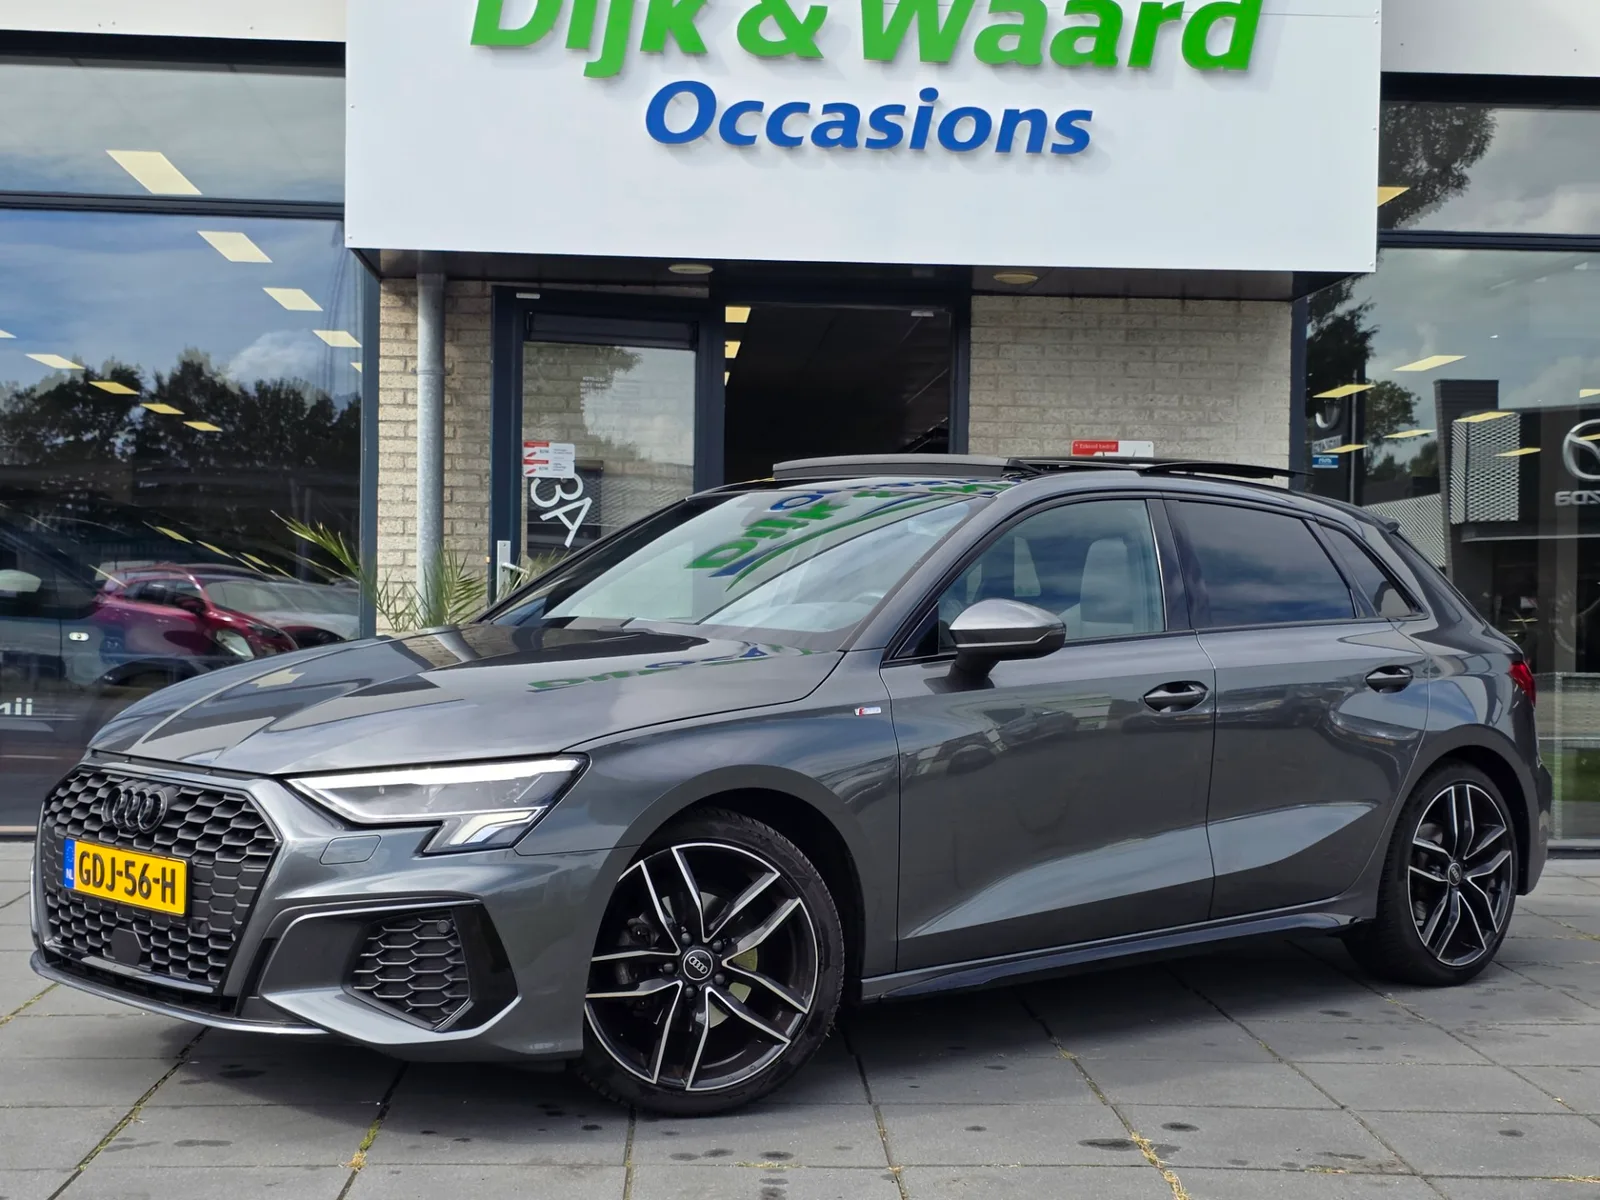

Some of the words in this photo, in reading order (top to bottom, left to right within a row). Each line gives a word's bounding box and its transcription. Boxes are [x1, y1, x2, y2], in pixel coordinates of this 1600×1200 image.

[736, 0, 828, 58] &
[860, 0, 1263, 71] Waard
[645, 80, 1094, 155] Occasions
[65, 868, 74, 880] NL
[78, 850, 176, 905] GDJ-56-H
